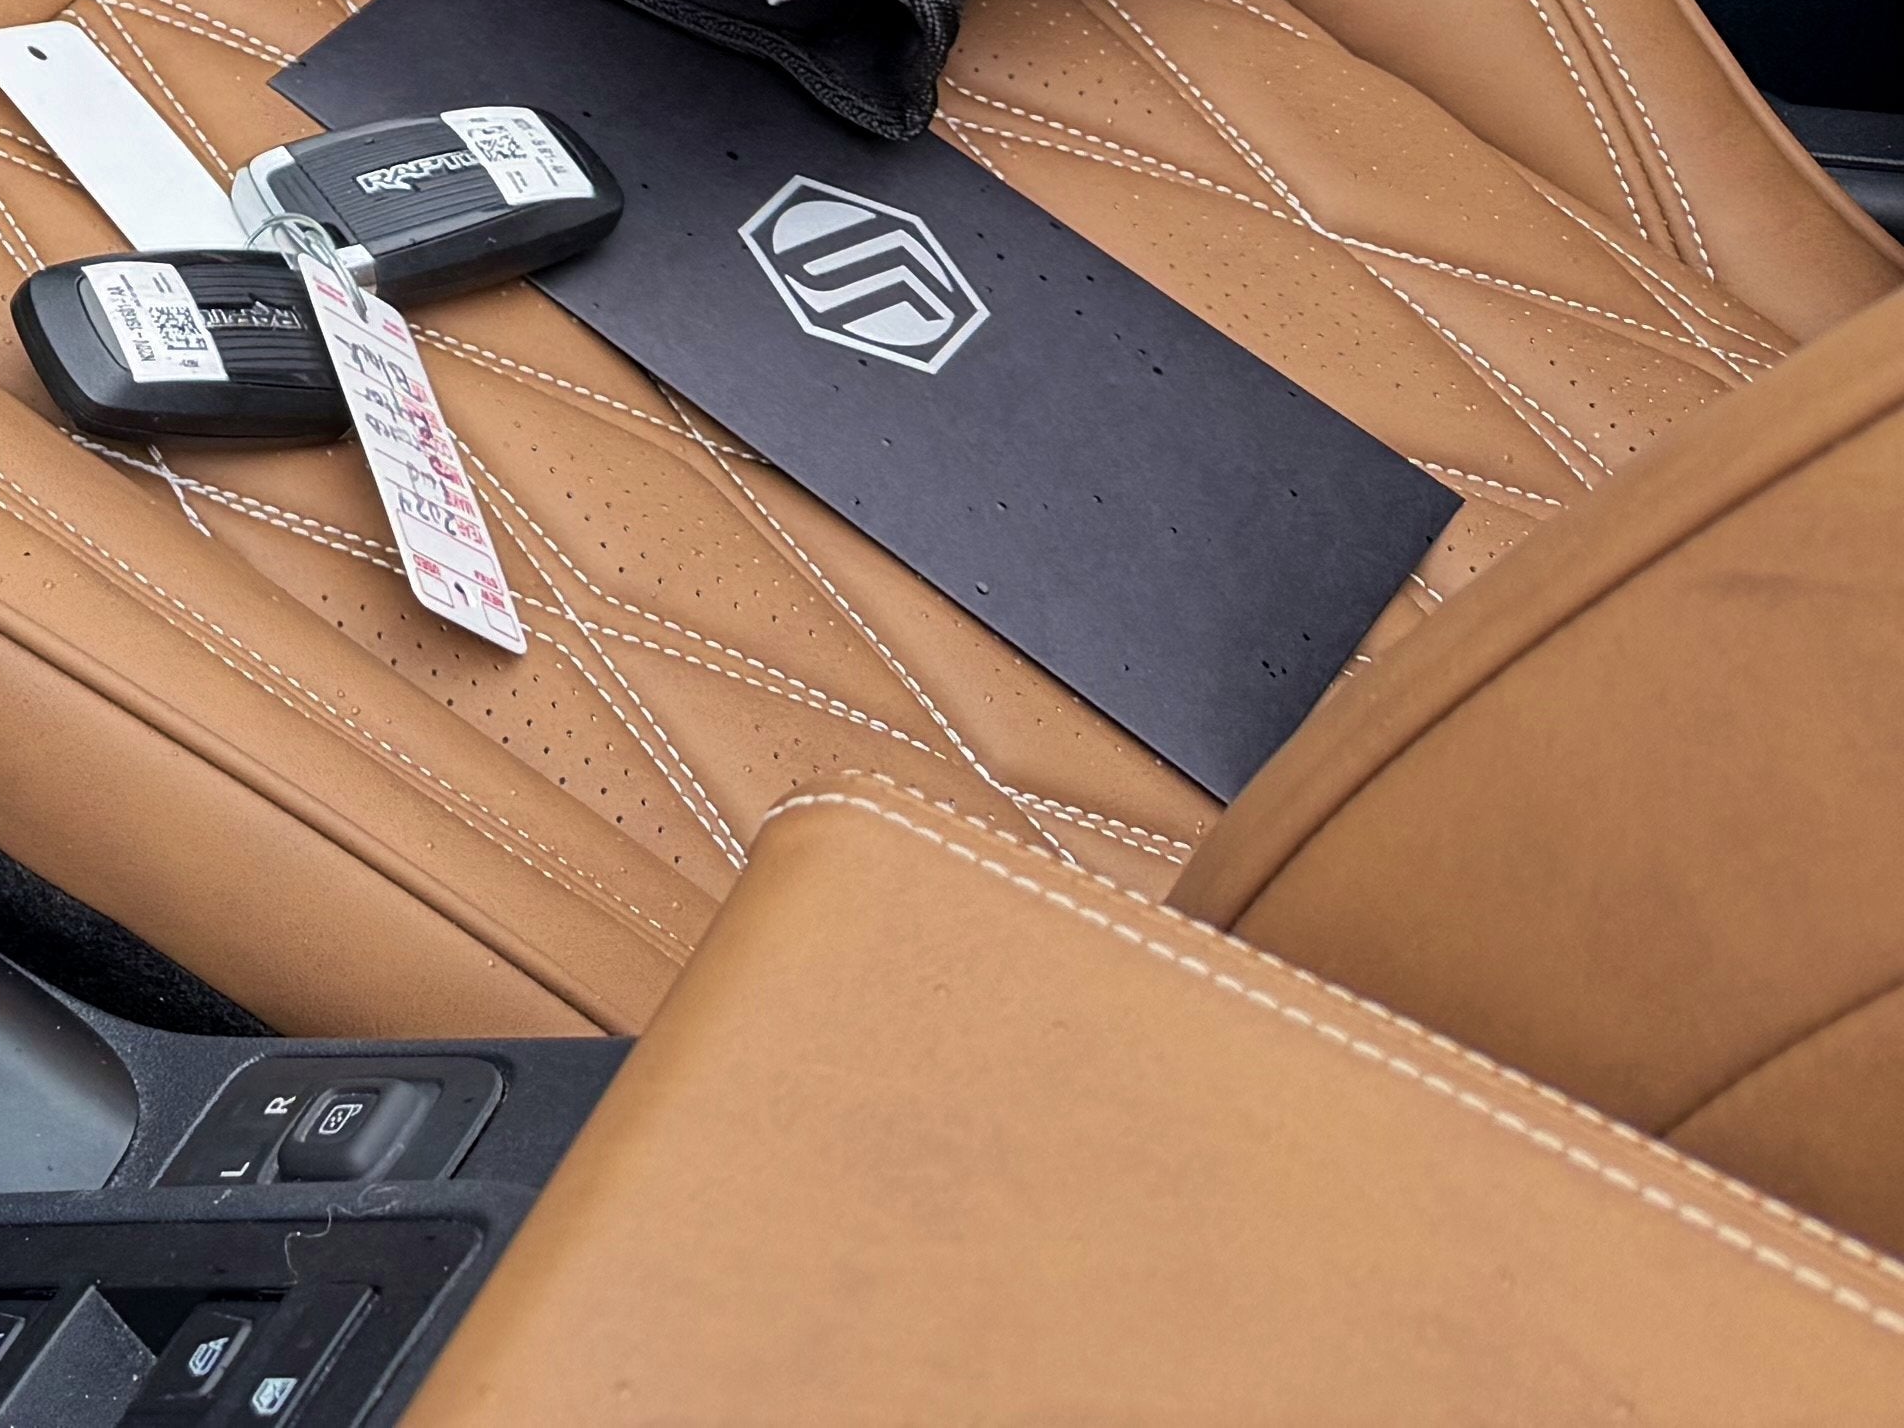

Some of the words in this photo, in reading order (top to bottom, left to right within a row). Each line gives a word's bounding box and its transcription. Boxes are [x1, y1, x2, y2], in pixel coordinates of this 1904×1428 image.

[398, 491, 456, 536] 2024
[265, 1094, 297, 1115] R
[220, 1160, 250, 1179] L
